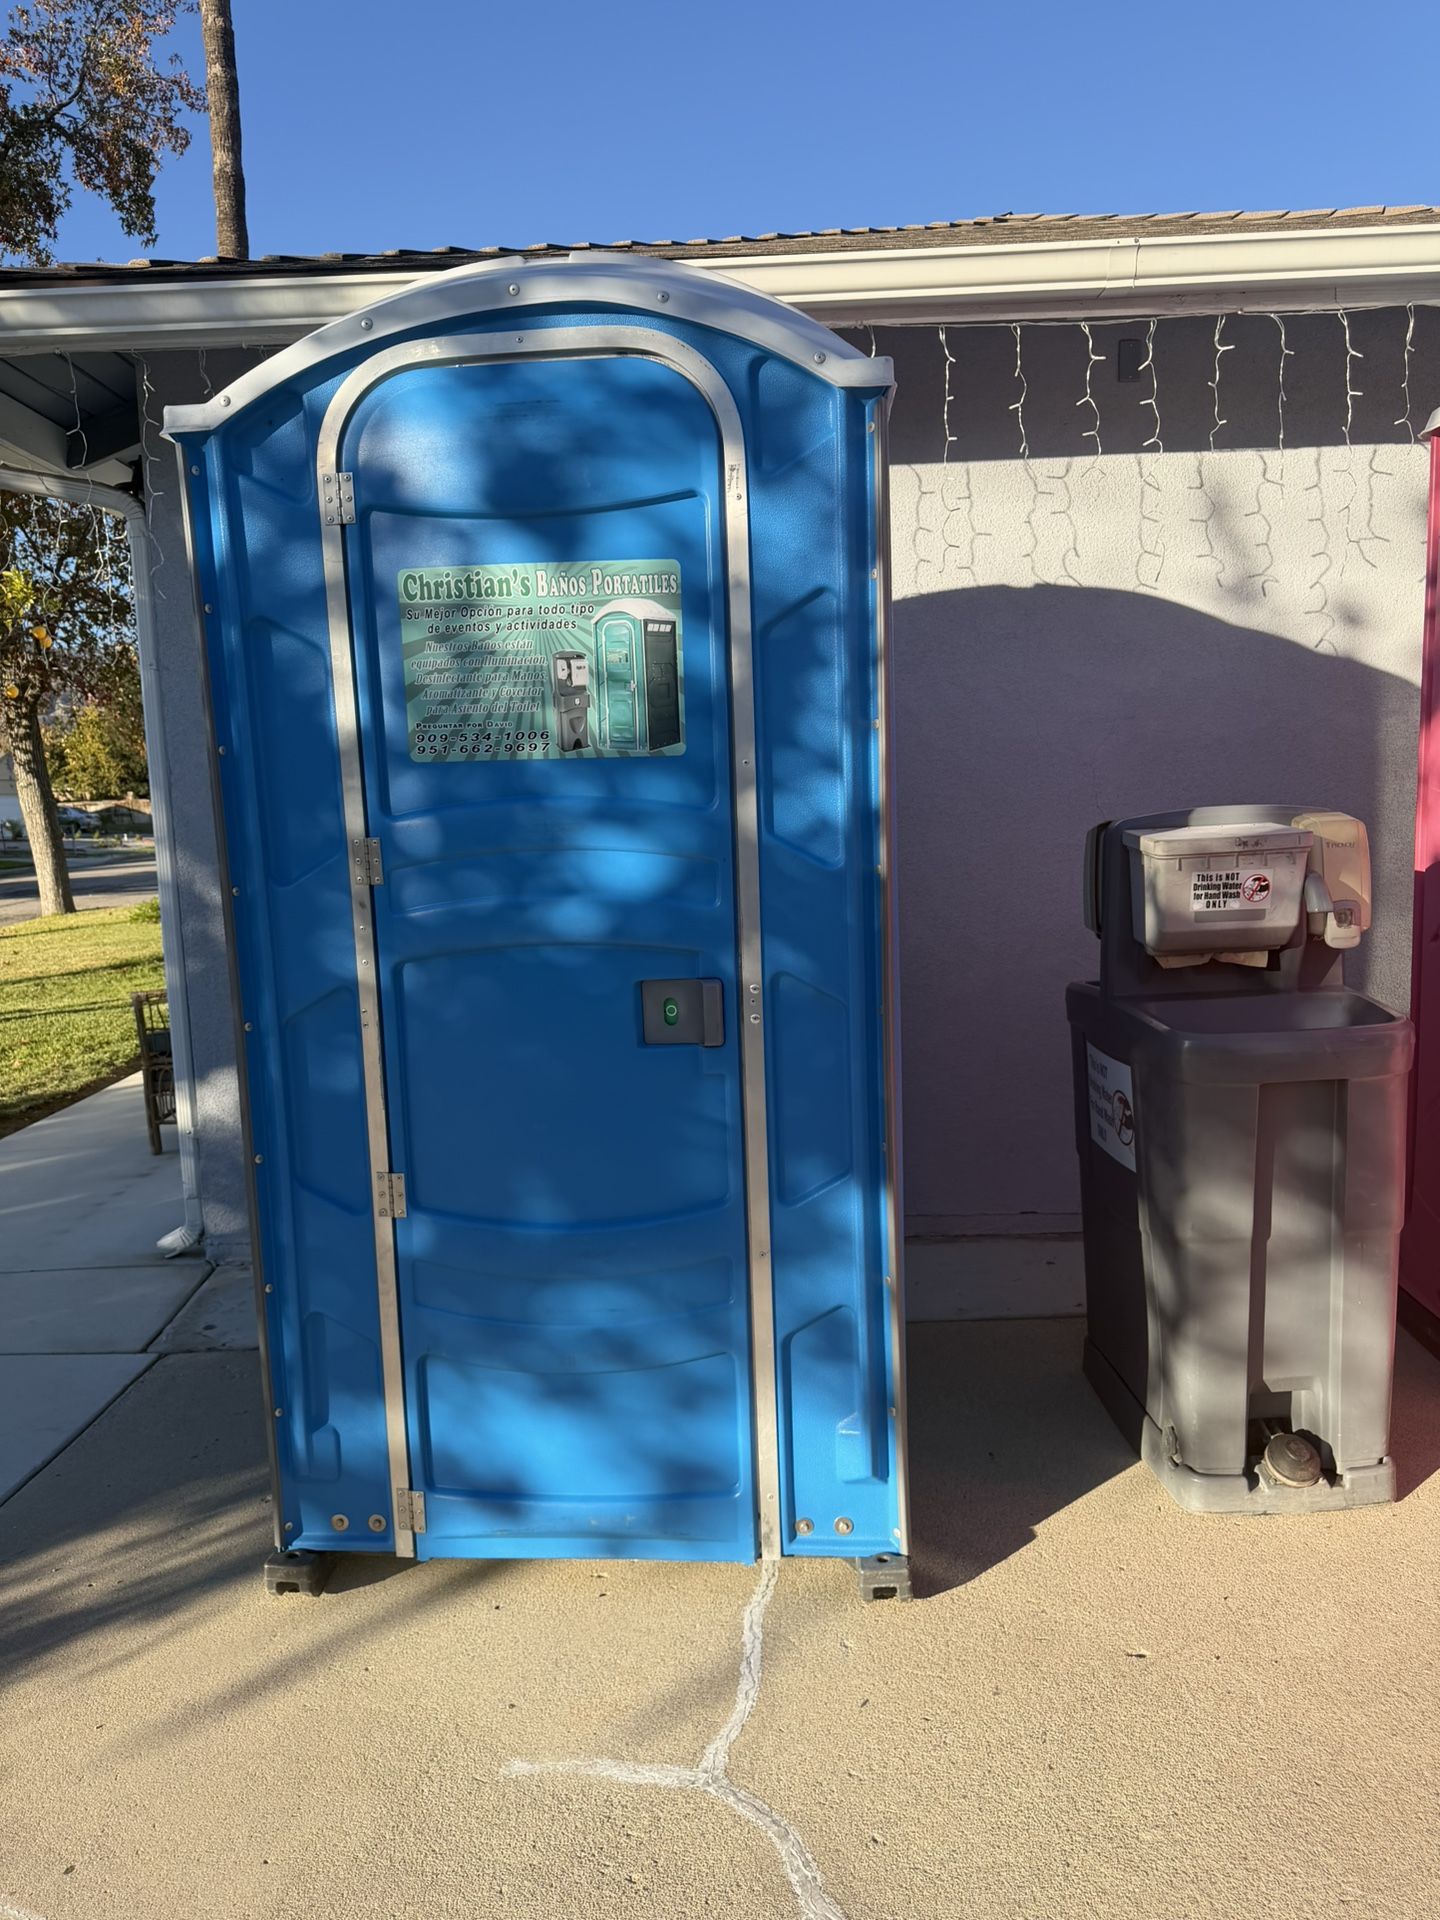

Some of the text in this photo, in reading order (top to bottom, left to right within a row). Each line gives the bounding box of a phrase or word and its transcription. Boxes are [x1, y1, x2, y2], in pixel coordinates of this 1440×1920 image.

[403, 568, 531, 602] Christian's
[406, 604, 594, 621] Su Mejor Opción para todo tipo
[427, 618, 577, 634] de eventos y actividades
[425, 640, 468, 652] Nuestros
[470, 640, 502, 652] Baños
[410, 658, 460, 670] equipados
[463, 658, 482, 668] con
[415, 672, 482, 684] Desinfectante
[484, 672, 508, 682] para
[422, 686, 544, 700] Aromatizante y Covertor
[426, 700, 540, 716] para Asiento del Toilet
[416, 730, 550, 743] 909-534-1006
[416, 742, 550, 754] 951-662-9697
[1197, 872, 1240, 882] This is NOT
[1193, 882, 1242, 892] Drinking Water
[1194, 890, 1241, 900] for Hand Wash
[1206, 900, 1228, 908] ONLY
